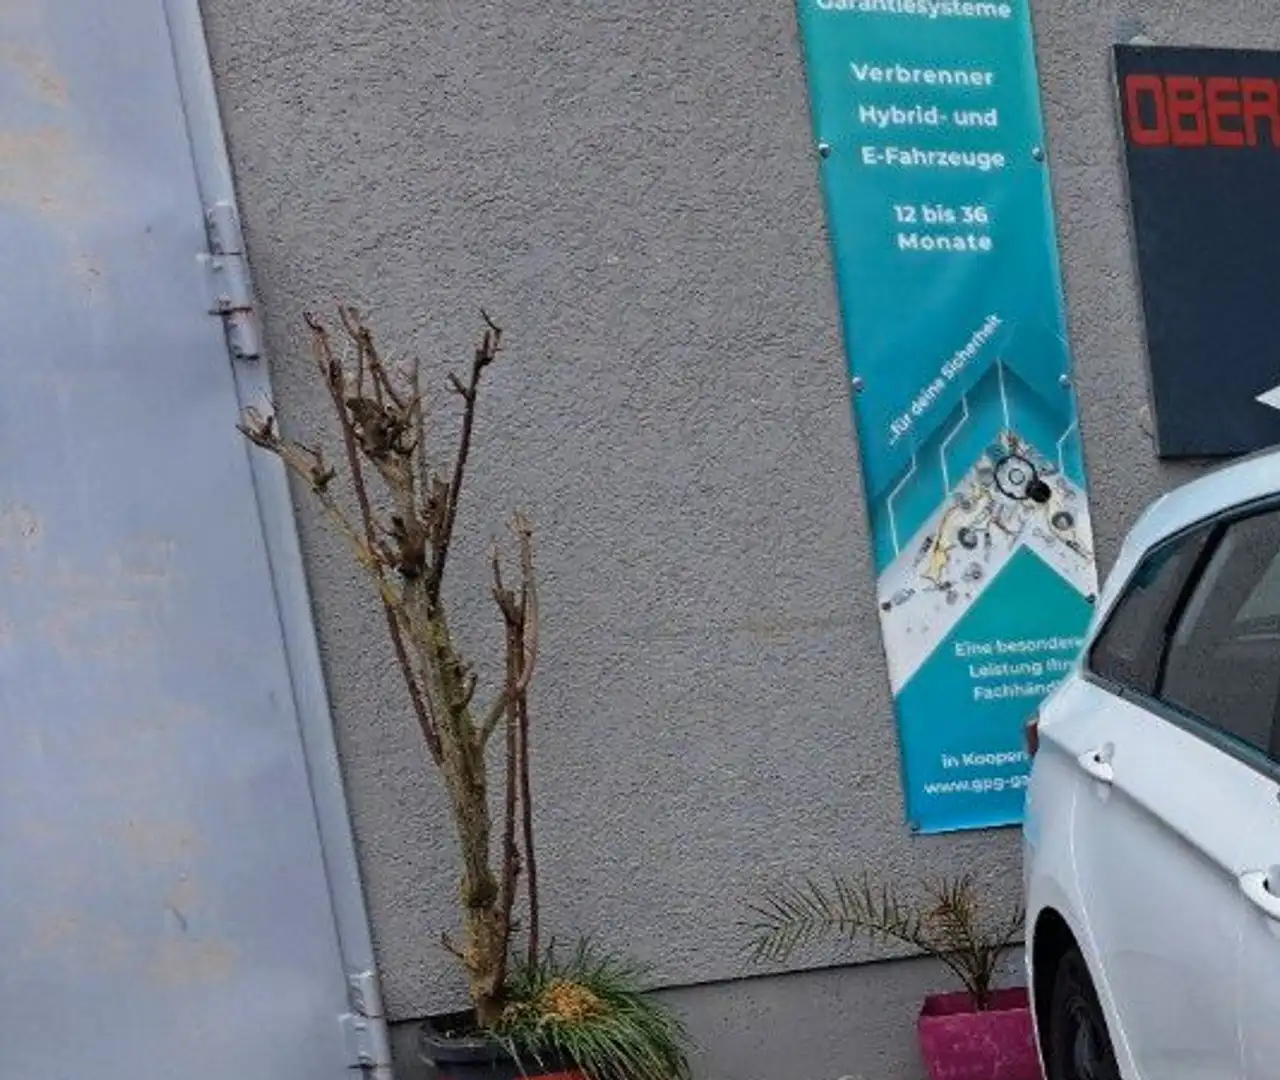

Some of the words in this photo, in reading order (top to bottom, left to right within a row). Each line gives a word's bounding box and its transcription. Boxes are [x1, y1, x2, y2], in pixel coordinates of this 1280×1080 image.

[850, 63, 994, 85] Verbrenner
[859, 105, 947, 128] Hybrid-
[953, 108, 998, 127] und
[861, 147, 1006, 171] E-Fahrzeuge
[894, 206, 917, 223] 12
[923, 206, 956, 224] bis
[961, 206, 989, 224] 36
[897, 233, 994, 251] Monate
[954, 642, 993, 657] Eine
[969, 661, 1042, 679] Leistung
